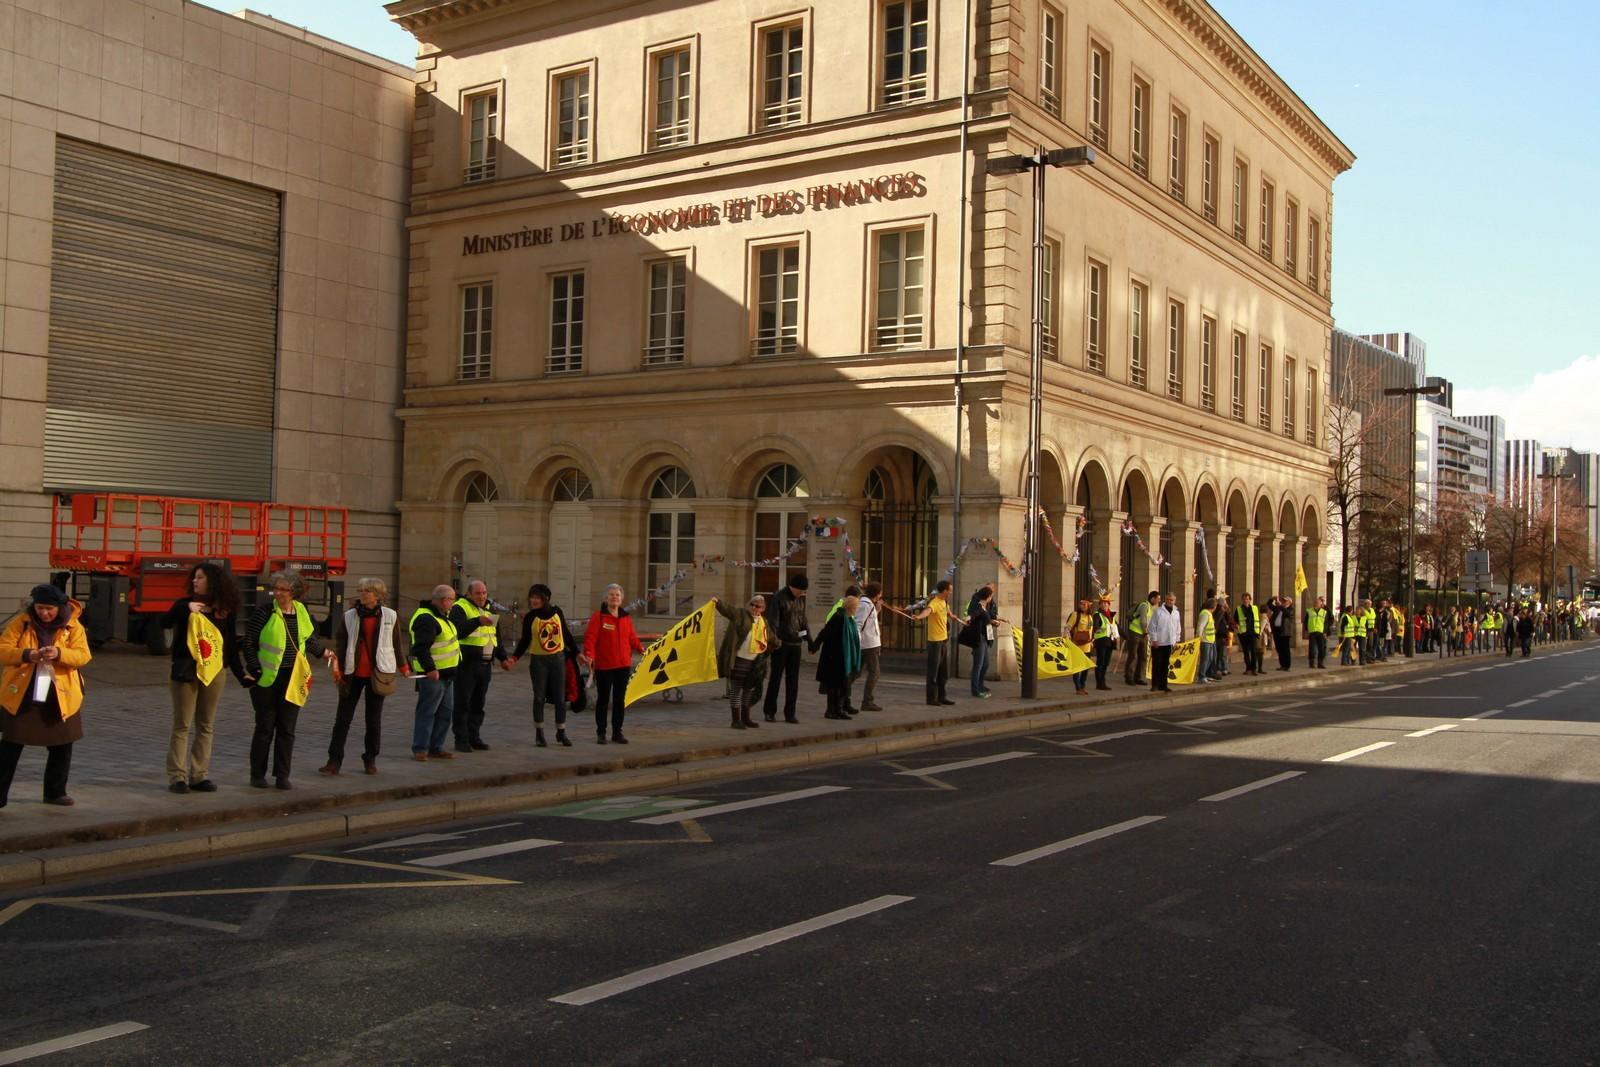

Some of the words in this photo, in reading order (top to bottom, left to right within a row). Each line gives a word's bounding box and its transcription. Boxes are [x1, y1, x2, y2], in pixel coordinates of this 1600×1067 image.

[560, 222, 585, 242] DE
[723, 196, 750, 219] ET
[756, 189, 798, 215] DES
[806, 170, 919, 206] FINANCES
